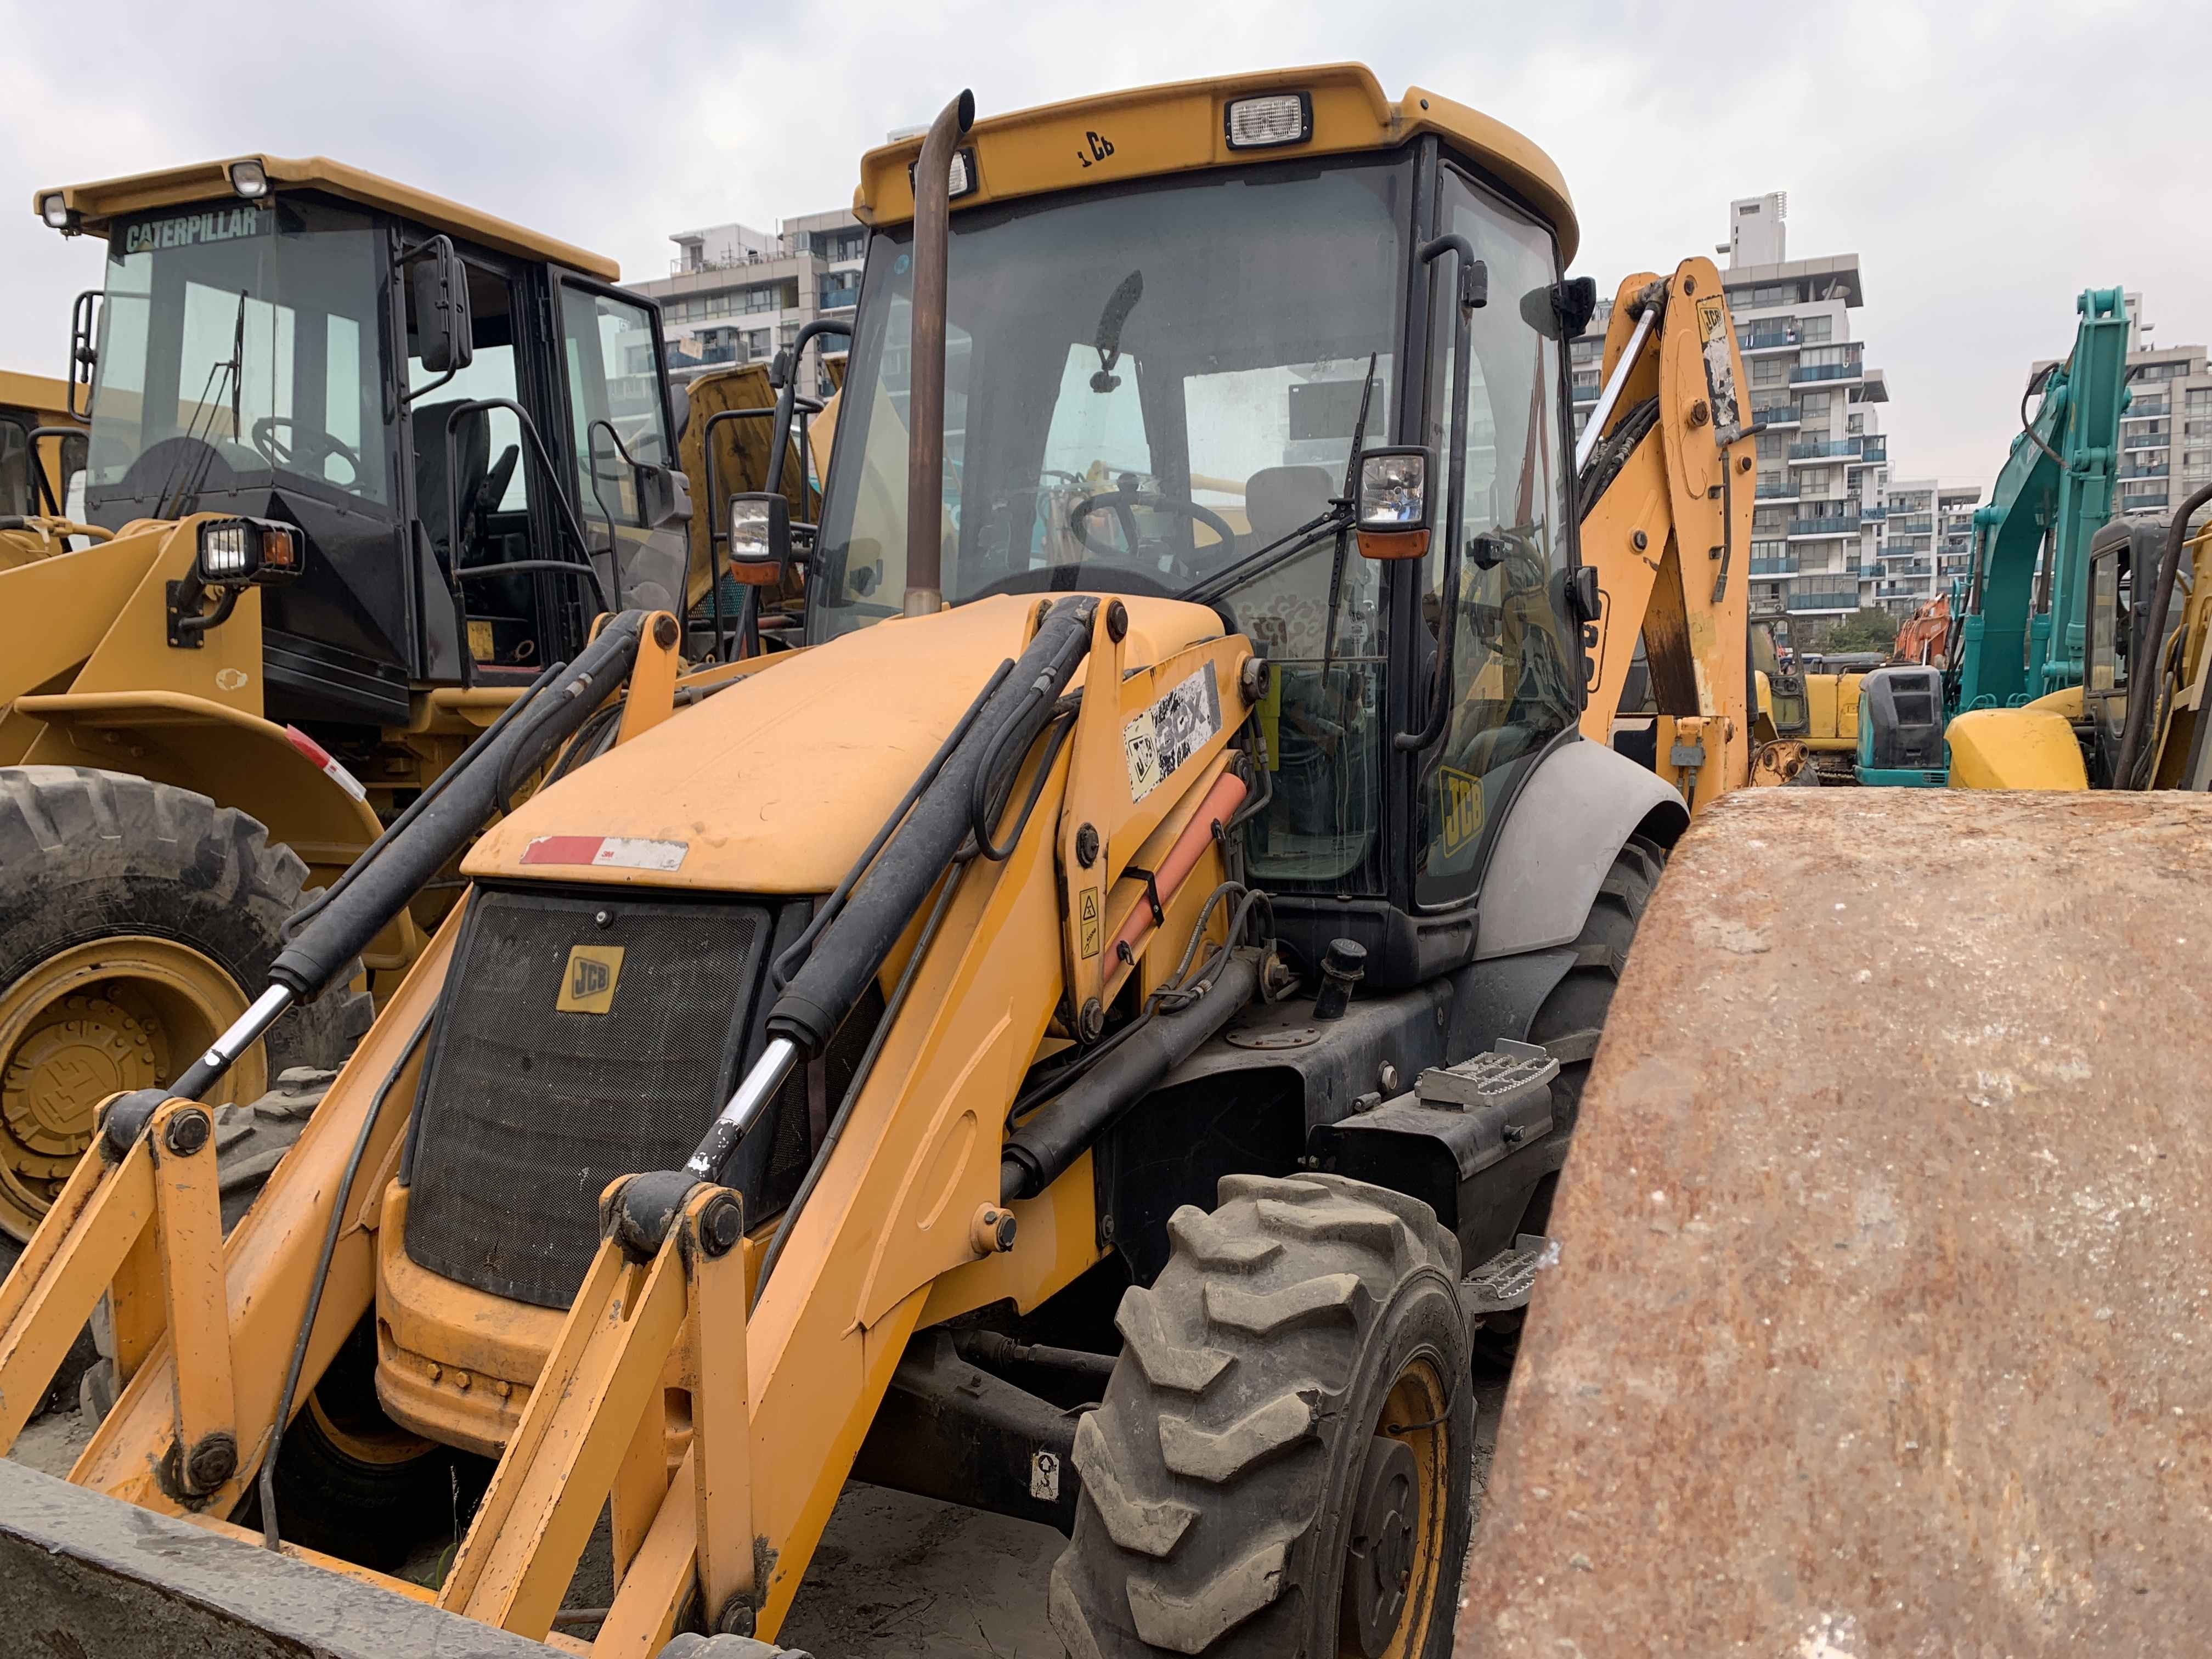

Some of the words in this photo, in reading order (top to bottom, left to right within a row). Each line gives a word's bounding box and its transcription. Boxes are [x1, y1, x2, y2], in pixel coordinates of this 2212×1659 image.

[126, 206, 257, 253] CATERPILLAR
[1157, 690, 1206, 756] 3CX
[1446, 777, 1482, 847] JCB
[575, 961, 606, 995] JCB
